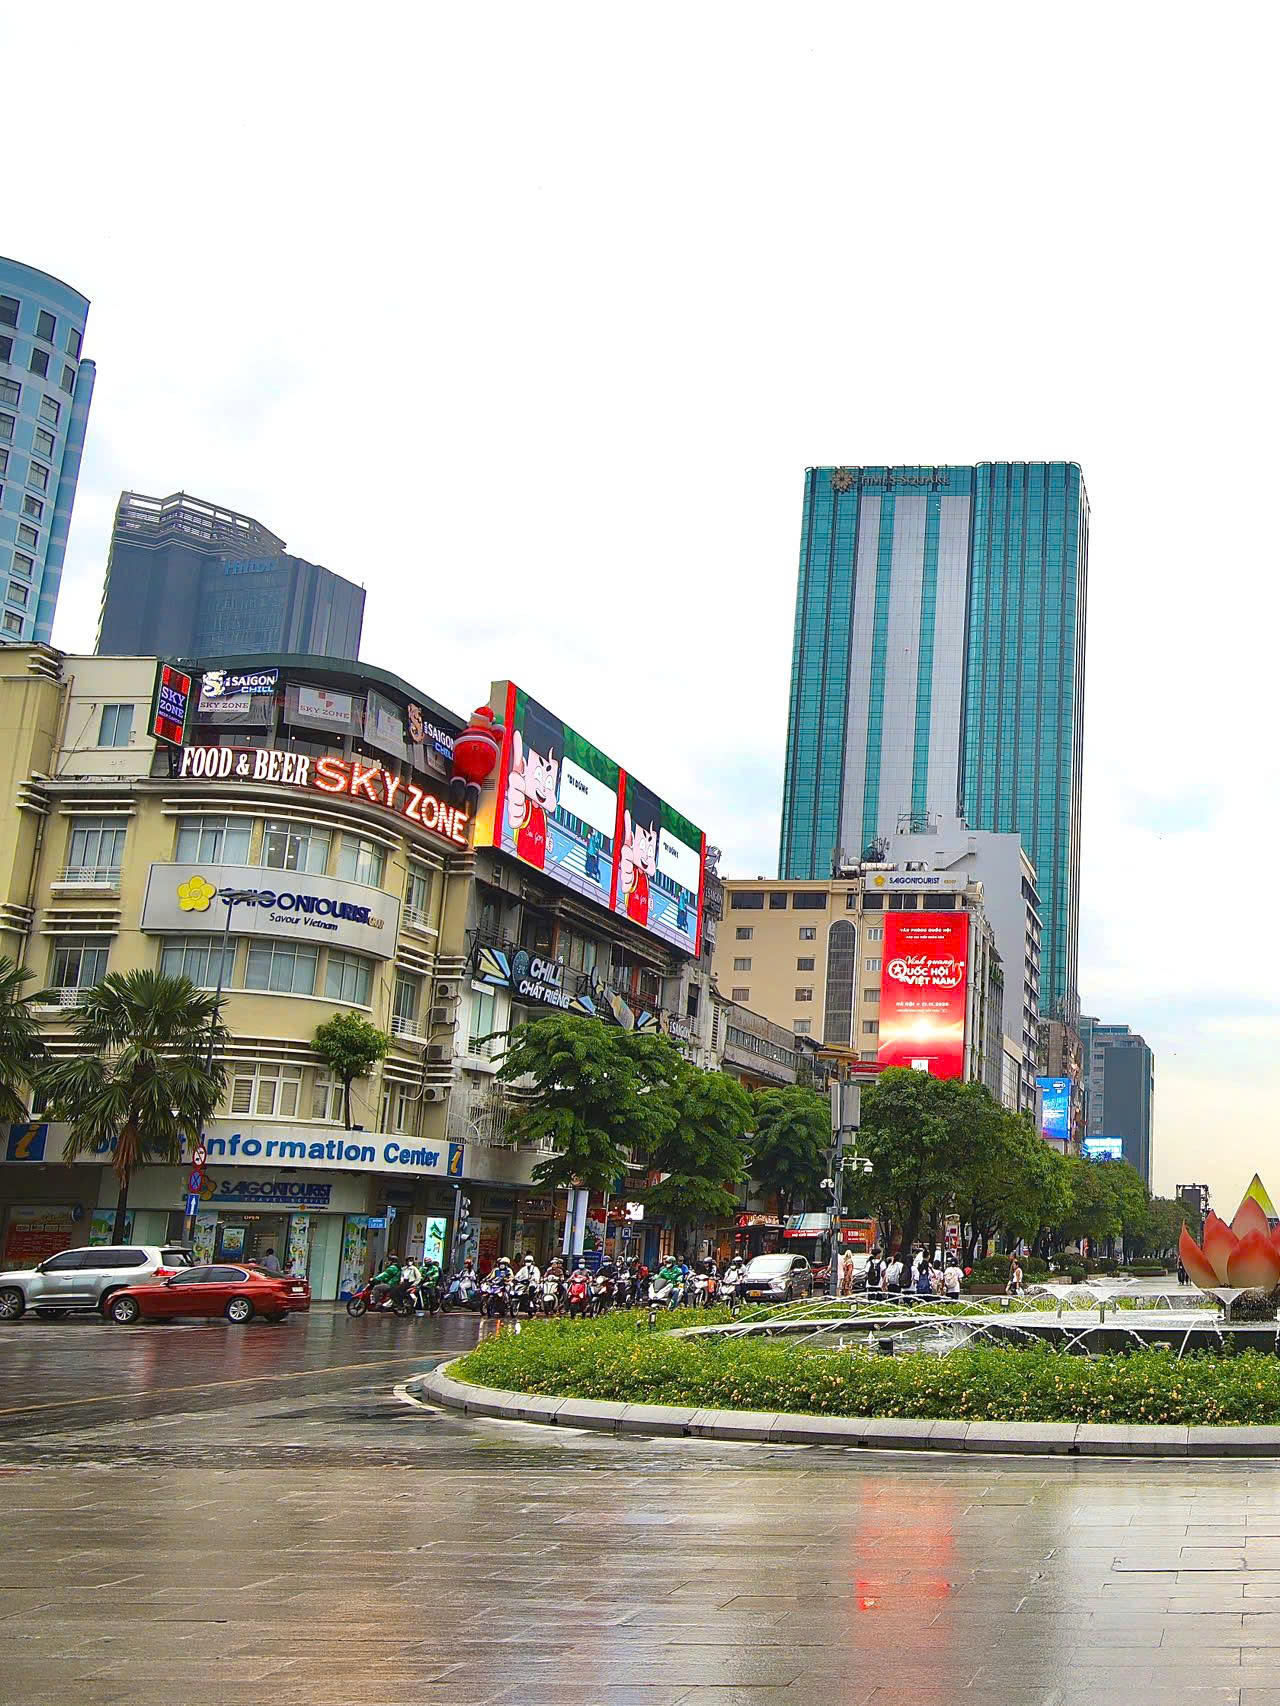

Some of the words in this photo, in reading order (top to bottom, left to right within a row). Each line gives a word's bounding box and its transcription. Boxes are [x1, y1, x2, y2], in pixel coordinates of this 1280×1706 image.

[161, 686, 186, 707] SKY
[200, 701, 220, 709] SKY
[222, 702, 249, 710] ZONE
[160, 699, 184, 719] ZONE
[300, 704, 320, 714] SKY
[322, 710, 350, 720] ZONE
[179, 746, 233, 778] FOOD
[236, 752, 251, 776] &
[252, 749, 311, 786] BEER
[313, 755, 401, 808] SKY
[404, 784, 469, 846] ZONE
[889, 877, 940, 885] SAIGONTOURIST
[269, 911, 301, 926] Savour
[304, 914, 338, 931] Vietnam
[530, 957, 563, 987] CHILL
[930, 965, 949, 977] HỘI
[931, 976, 956, 985] NAM
[519, 980, 545, 999] CHẤT
[543, 988, 570, 1009] RIÊNG
[383, 1142, 440, 1168] Center
[220, 1180, 333, 1197] SAIGONTOURIST
